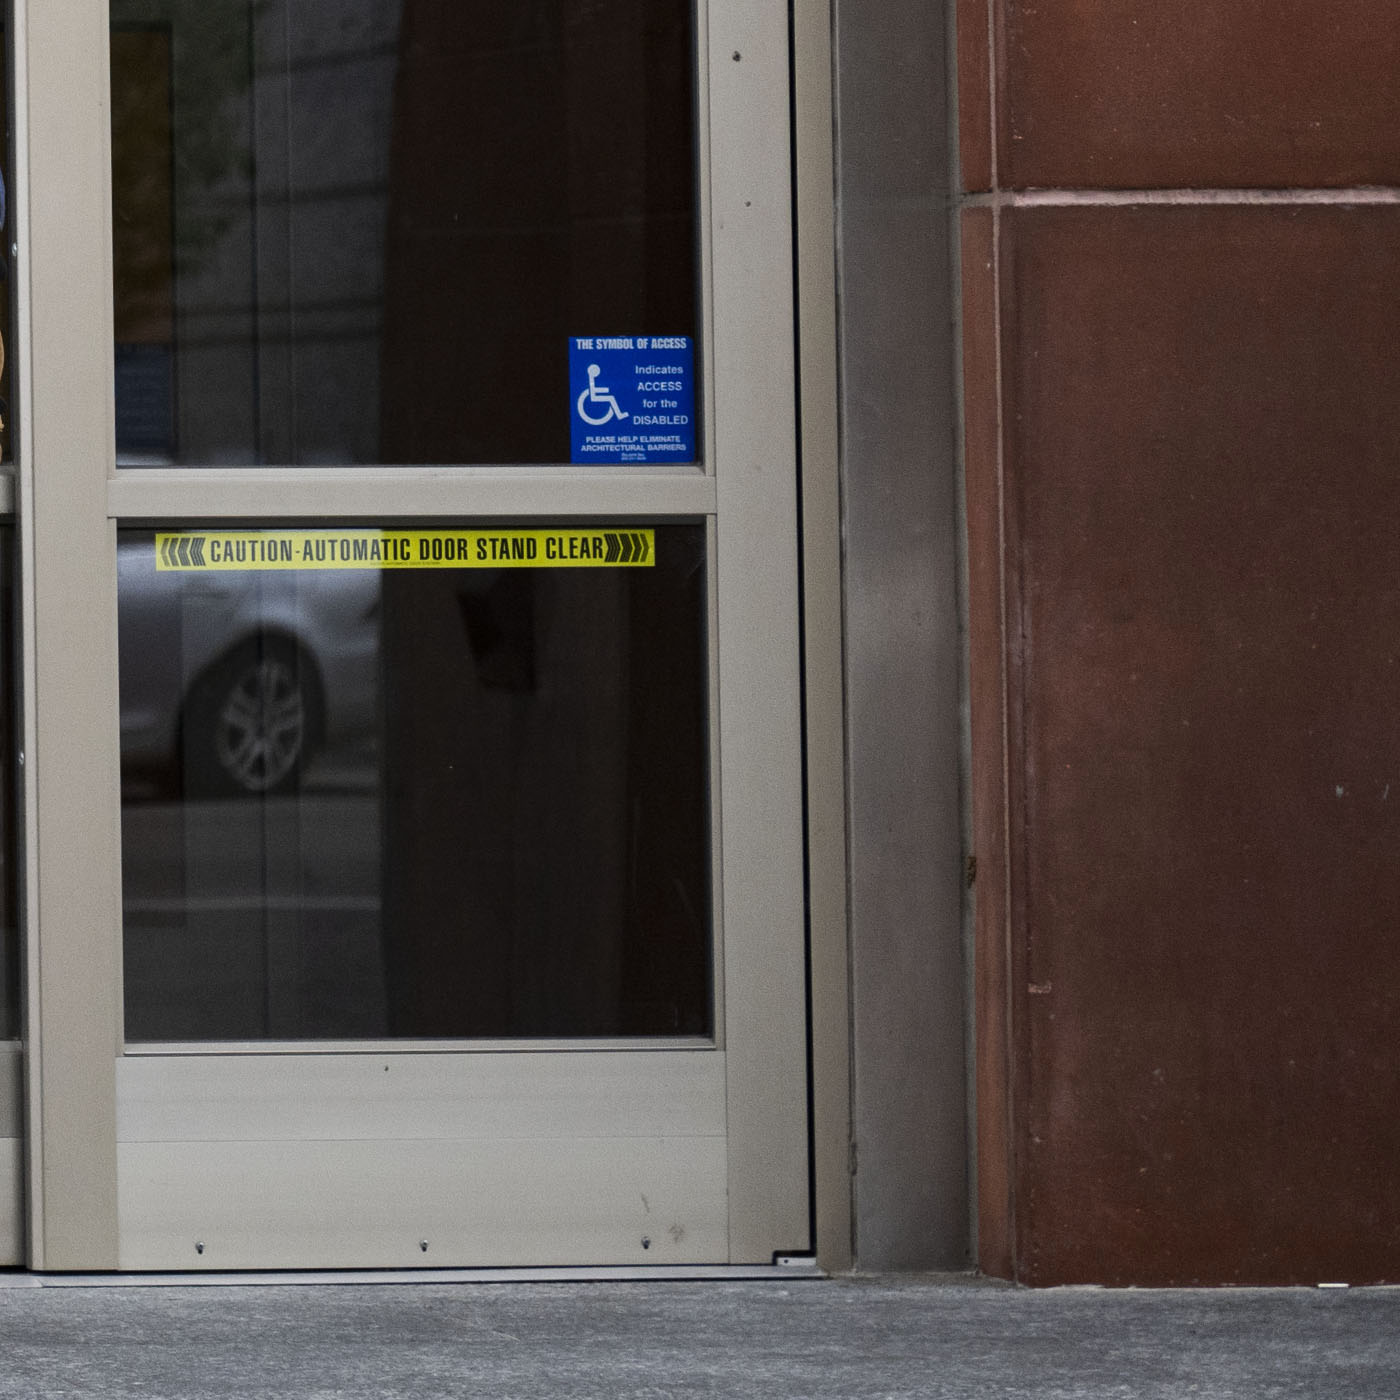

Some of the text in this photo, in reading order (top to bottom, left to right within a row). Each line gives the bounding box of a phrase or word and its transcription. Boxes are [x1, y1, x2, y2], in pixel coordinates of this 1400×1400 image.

[576, 338, 687, 350] THE SYMBOL OF ACCESS
[635, 365, 684, 375] Indicates
[637, 382, 683, 391] ACCESS
[643, 398, 678, 408] for the
[633, 415, 689, 425] DISABLED
[581, 444, 646, 452] ARCHITECTURAL
[419, 537, 468, 561] DOOR
[476, 536, 538, 560] STAND
[545, 535, 605, 560] CLEAR
